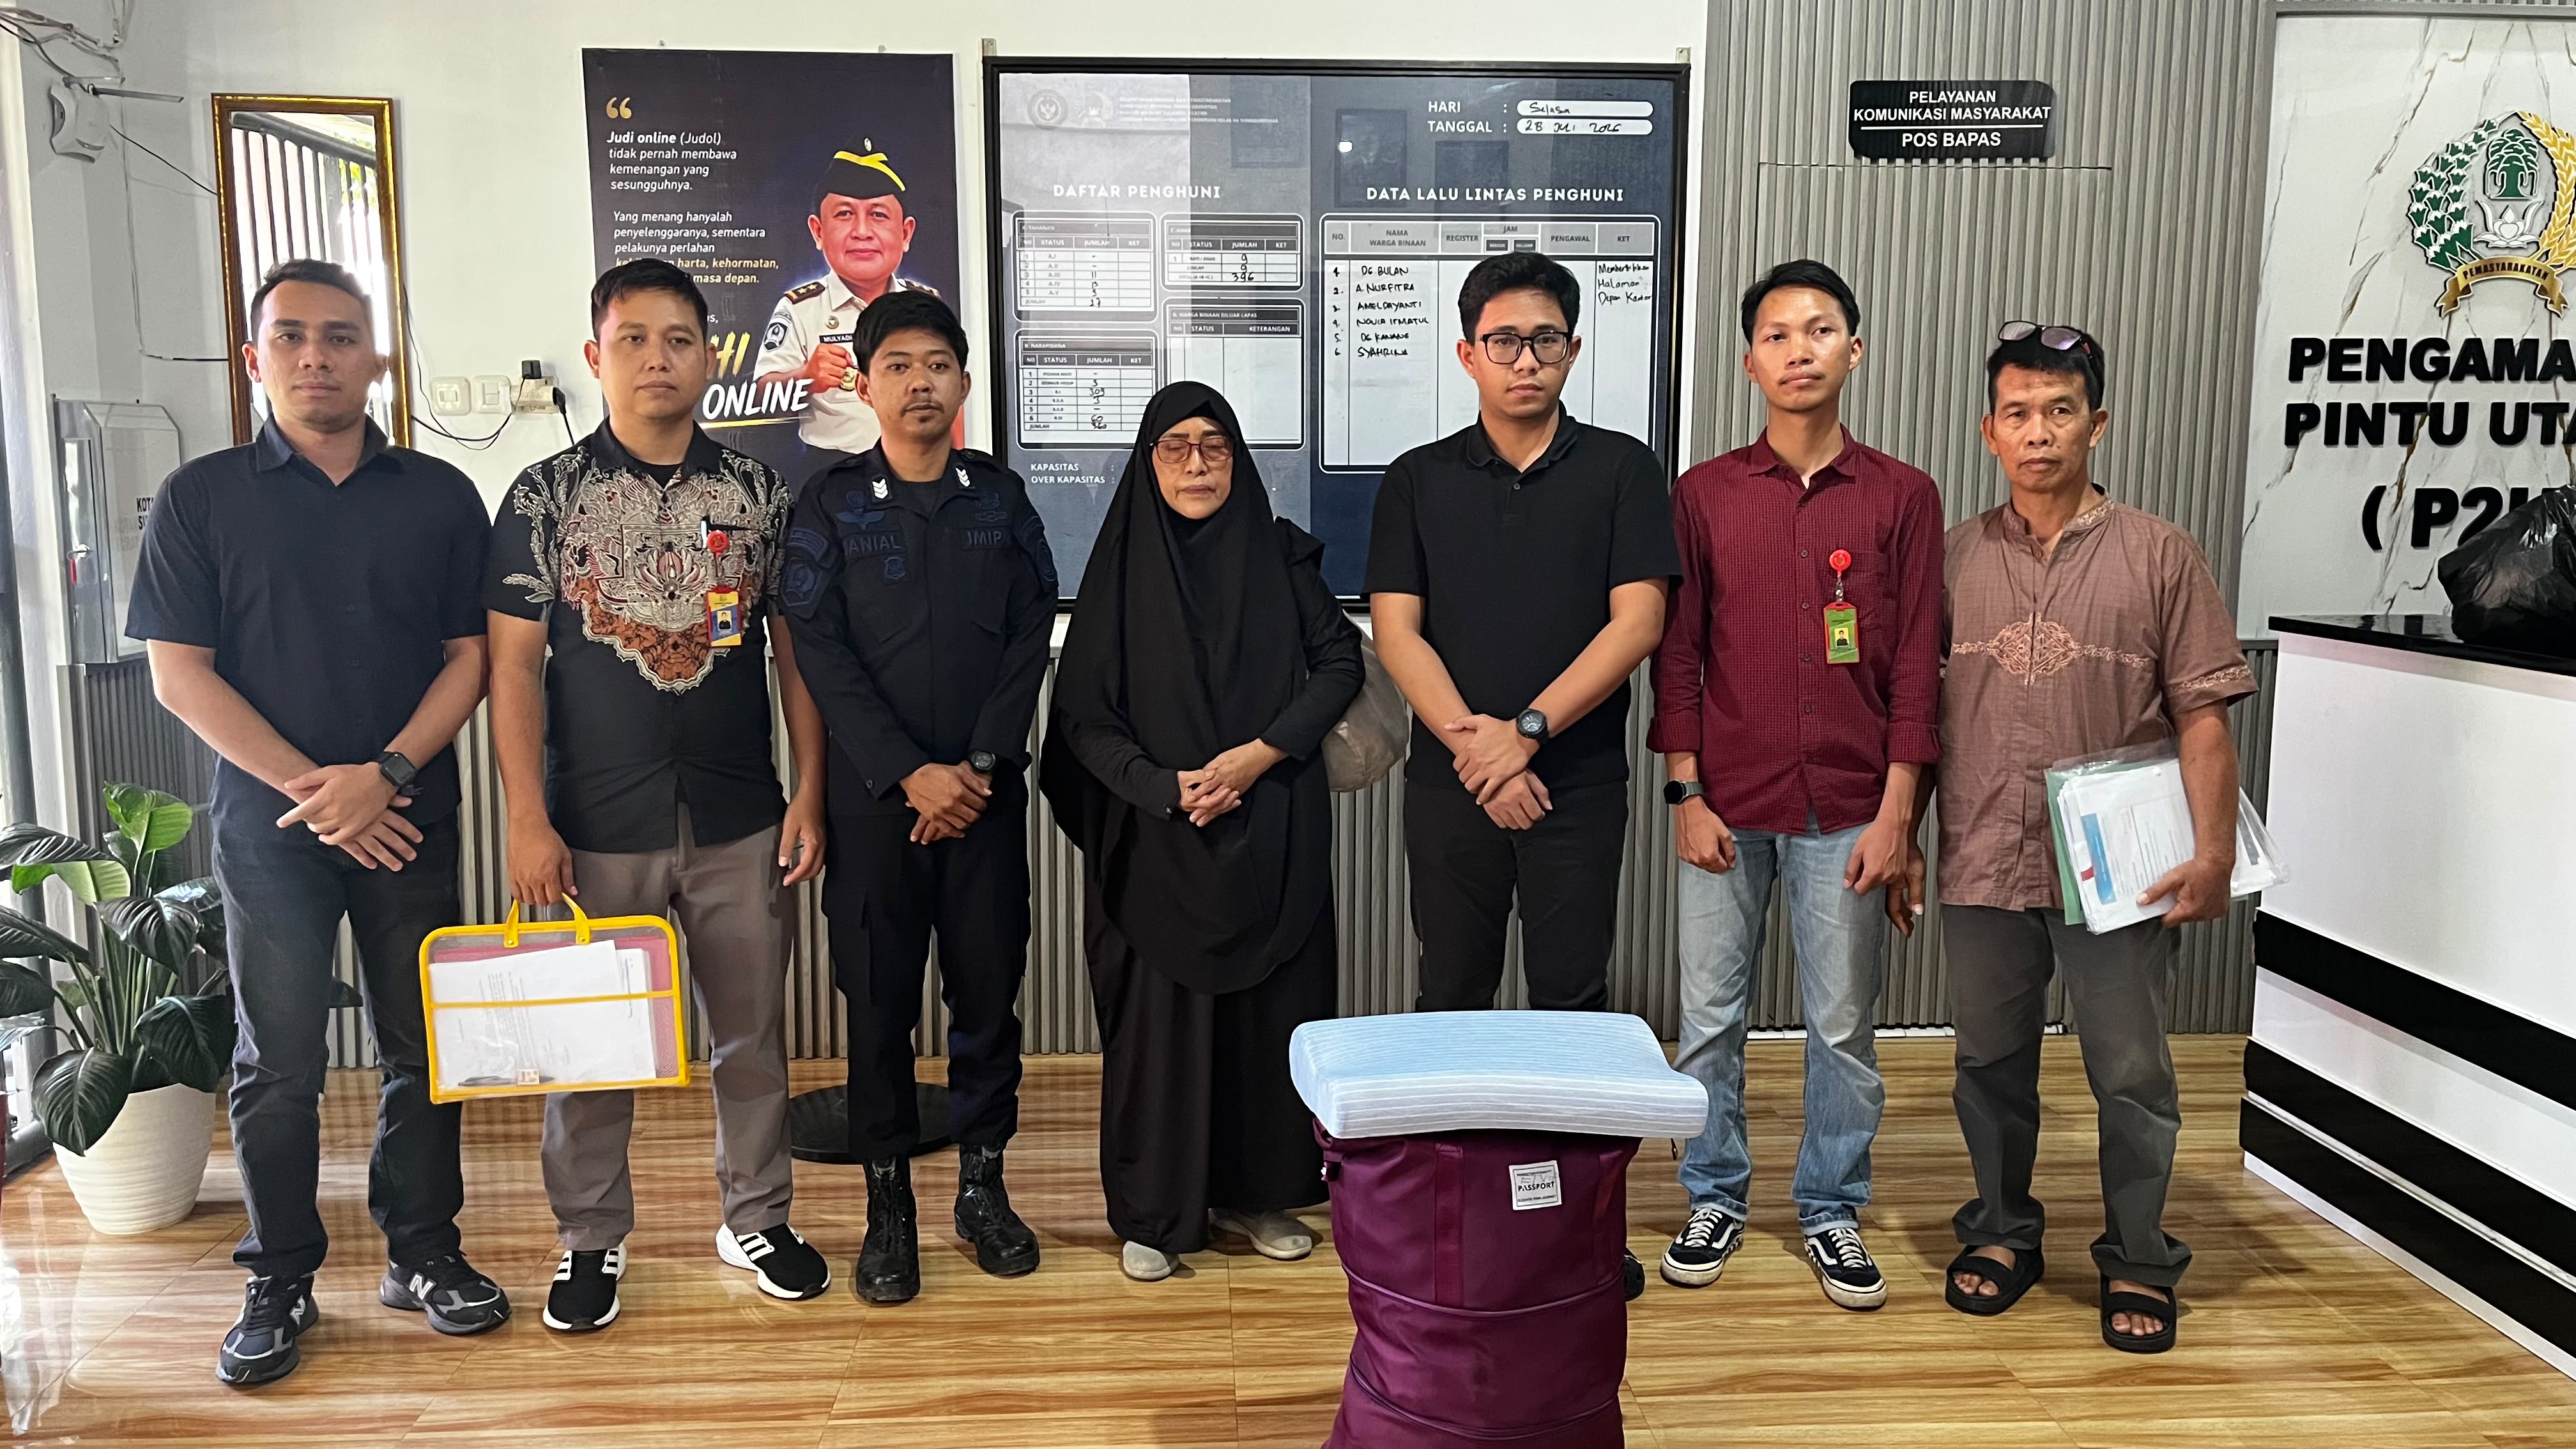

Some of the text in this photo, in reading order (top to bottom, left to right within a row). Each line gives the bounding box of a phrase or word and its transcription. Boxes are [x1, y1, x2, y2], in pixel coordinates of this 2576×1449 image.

[1910, 90, 1996, 103] PELAYANAN
[1428, 101, 1460, 112] HARI
[1854, 107, 2051, 121] KOMUNIKASI MASYARAKAT
[1428, 121, 1492, 132] TANGGAL
[607, 131, 721, 145] Judi online (Judol)
[1902, 132, 2001, 147] POS BAPAS
[609, 148, 737, 162] tidak pernah membawa
[610, 163, 709, 177] kemenangan yang
[610, 178, 693, 192] sesungguhnya.
[1054, 184, 1221, 199] DAFTAR PENGHUNI
[1367, 187, 1623, 201] DATA LALU LINTAS PENGHUNI
[613, 211, 732, 225] Yang menang hanyalah
[613, 227, 766, 240] penyelenggaranya, sementara
[1503, 226, 1518, 234] JAM
[615, 242, 715, 254] pelakunya perlahan
[677, 258, 709, 269] harta,
[712, 258, 779, 269] kehormatan,
[1377, 266, 1409, 276] BULAN
[2463, 263, 2550, 281] PEMASYARAKATAN
[693, 273, 759, 285] masa depan.
[1366, 283, 1414, 293] NURFITRA
[702, 376, 815, 420] ONLINE
[2284, 402, 2469, 446] PINTU
[1031, 463, 1079, 472] KAPASITAS
[1031, 475, 1105, 484] OVER KAPASITAS
[1518, 1181, 1554, 1192] PASSPORT
